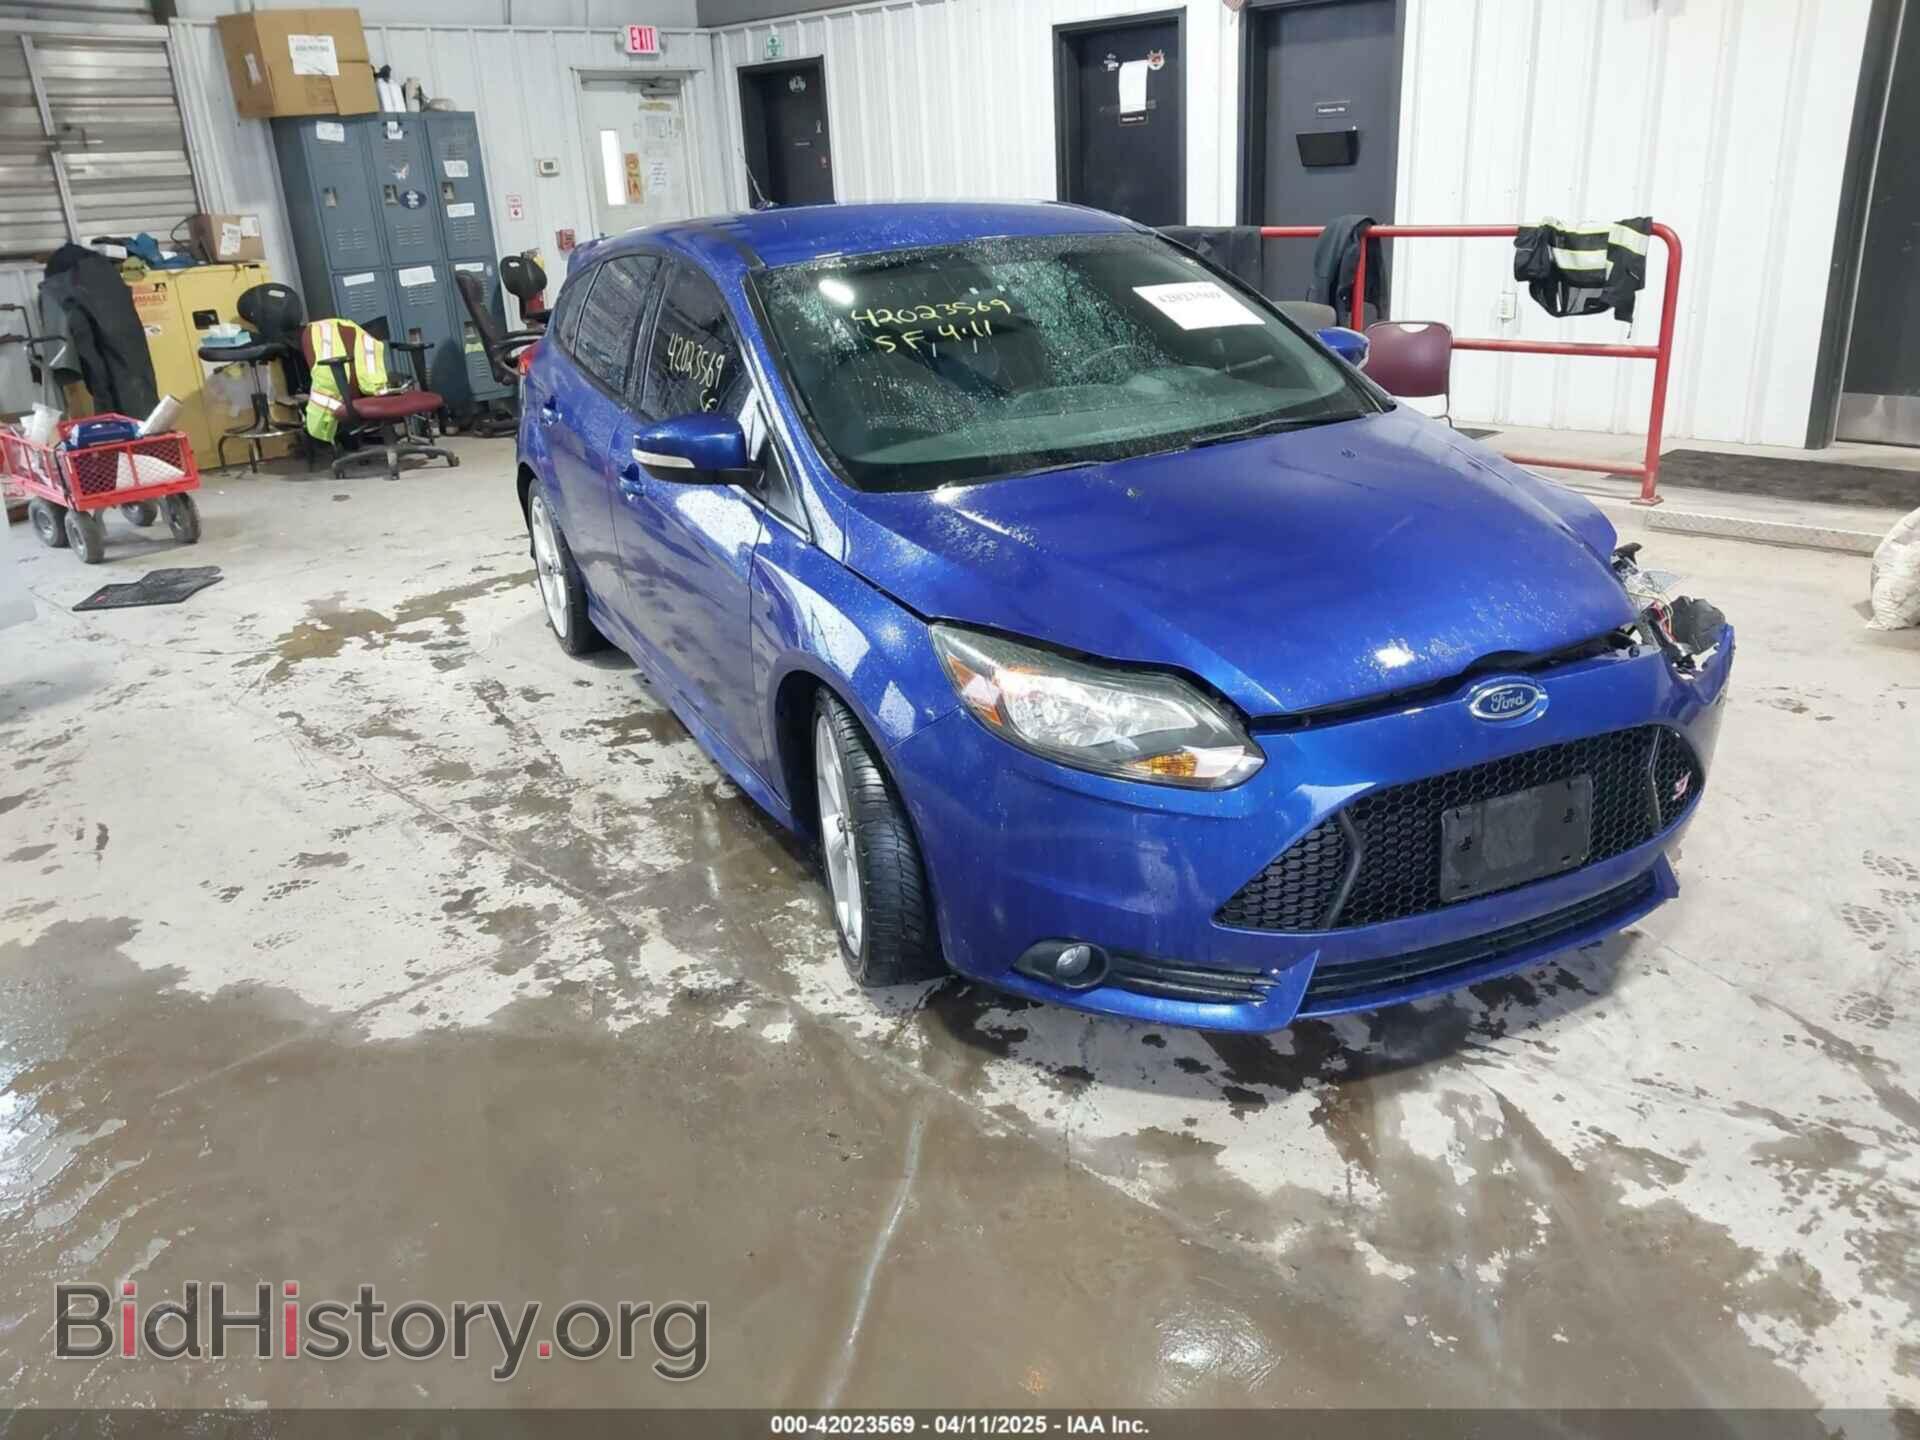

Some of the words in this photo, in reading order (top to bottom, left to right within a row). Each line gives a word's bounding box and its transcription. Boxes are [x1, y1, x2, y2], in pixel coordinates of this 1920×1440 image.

[630, 26, 655, 50] EXIT
[851, 299, 1011, 328] 42023569
[668, 332, 725, 390] 42023569
[1490, 689, 1526, 712] Ford
